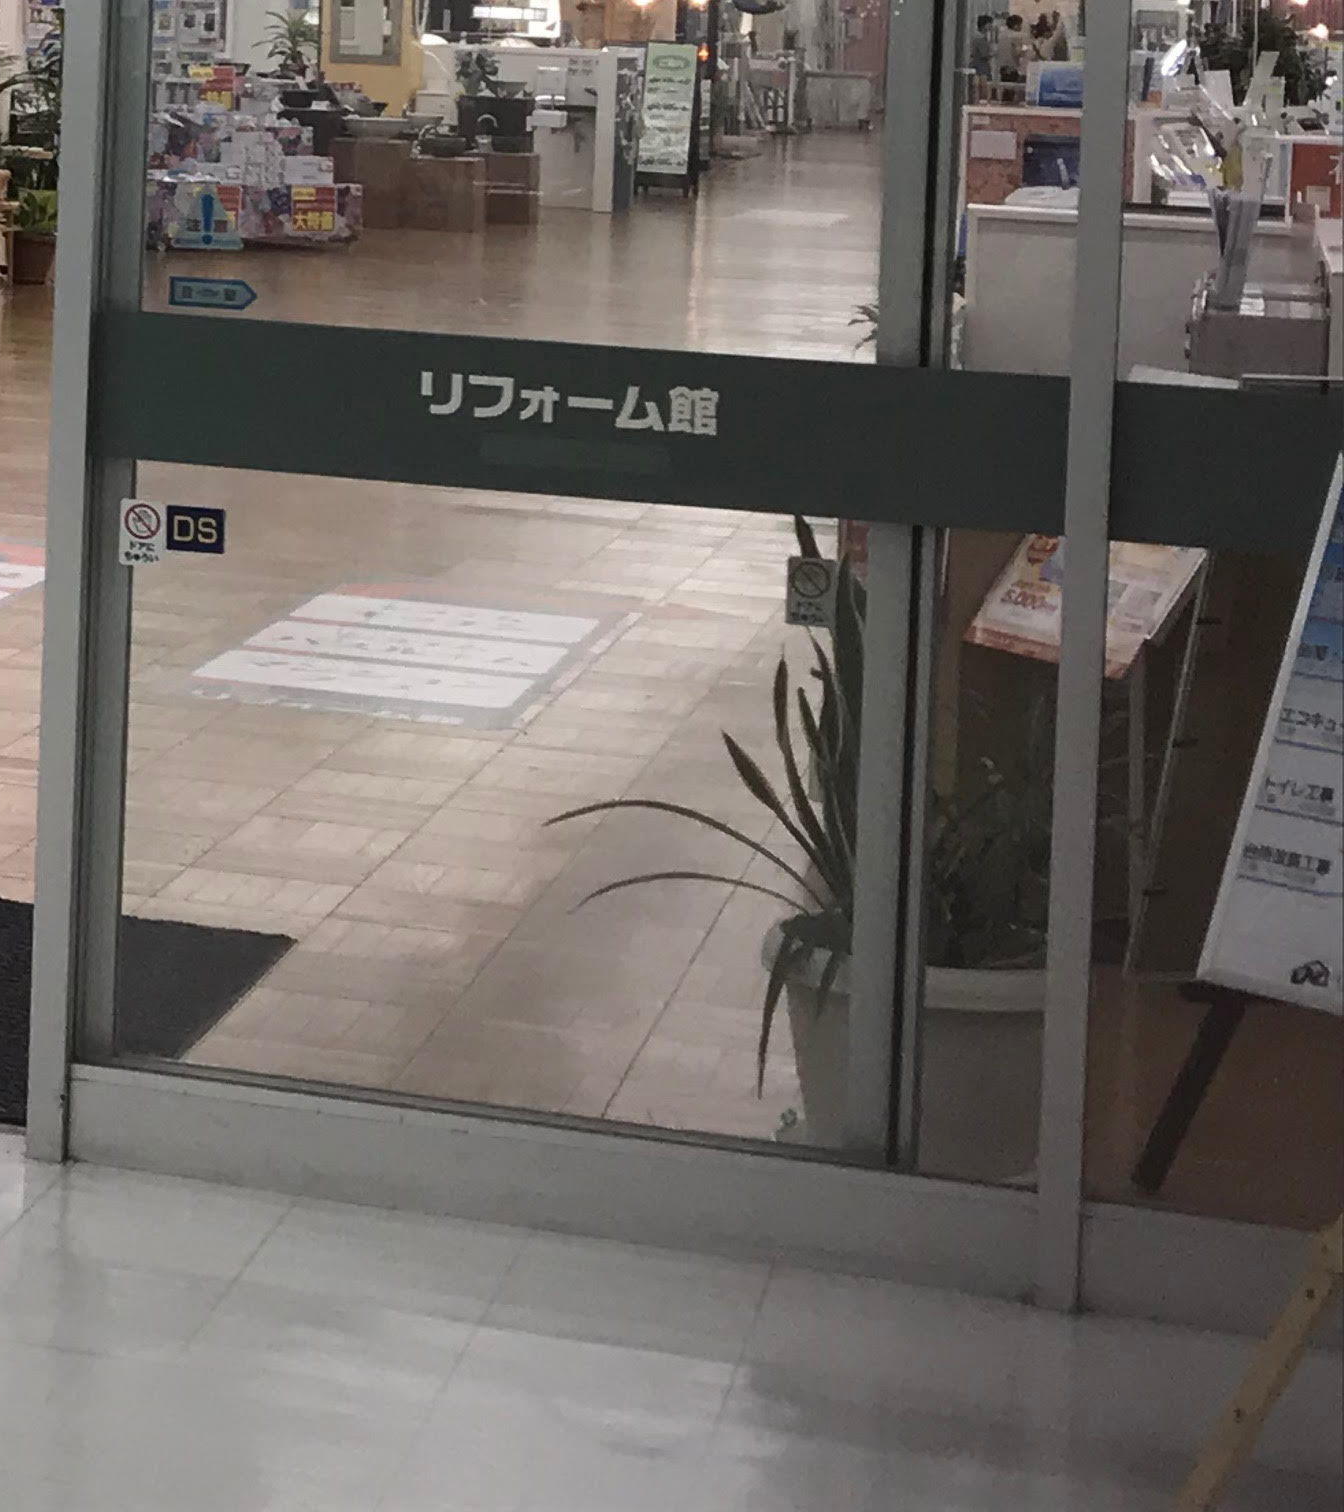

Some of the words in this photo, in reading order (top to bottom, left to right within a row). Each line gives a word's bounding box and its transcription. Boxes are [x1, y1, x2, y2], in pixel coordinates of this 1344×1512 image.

[419, 369, 721, 437] リフォーム館
[172, 514, 218, 544] DS
[1279, 706, 1344, 733] エコキュ
